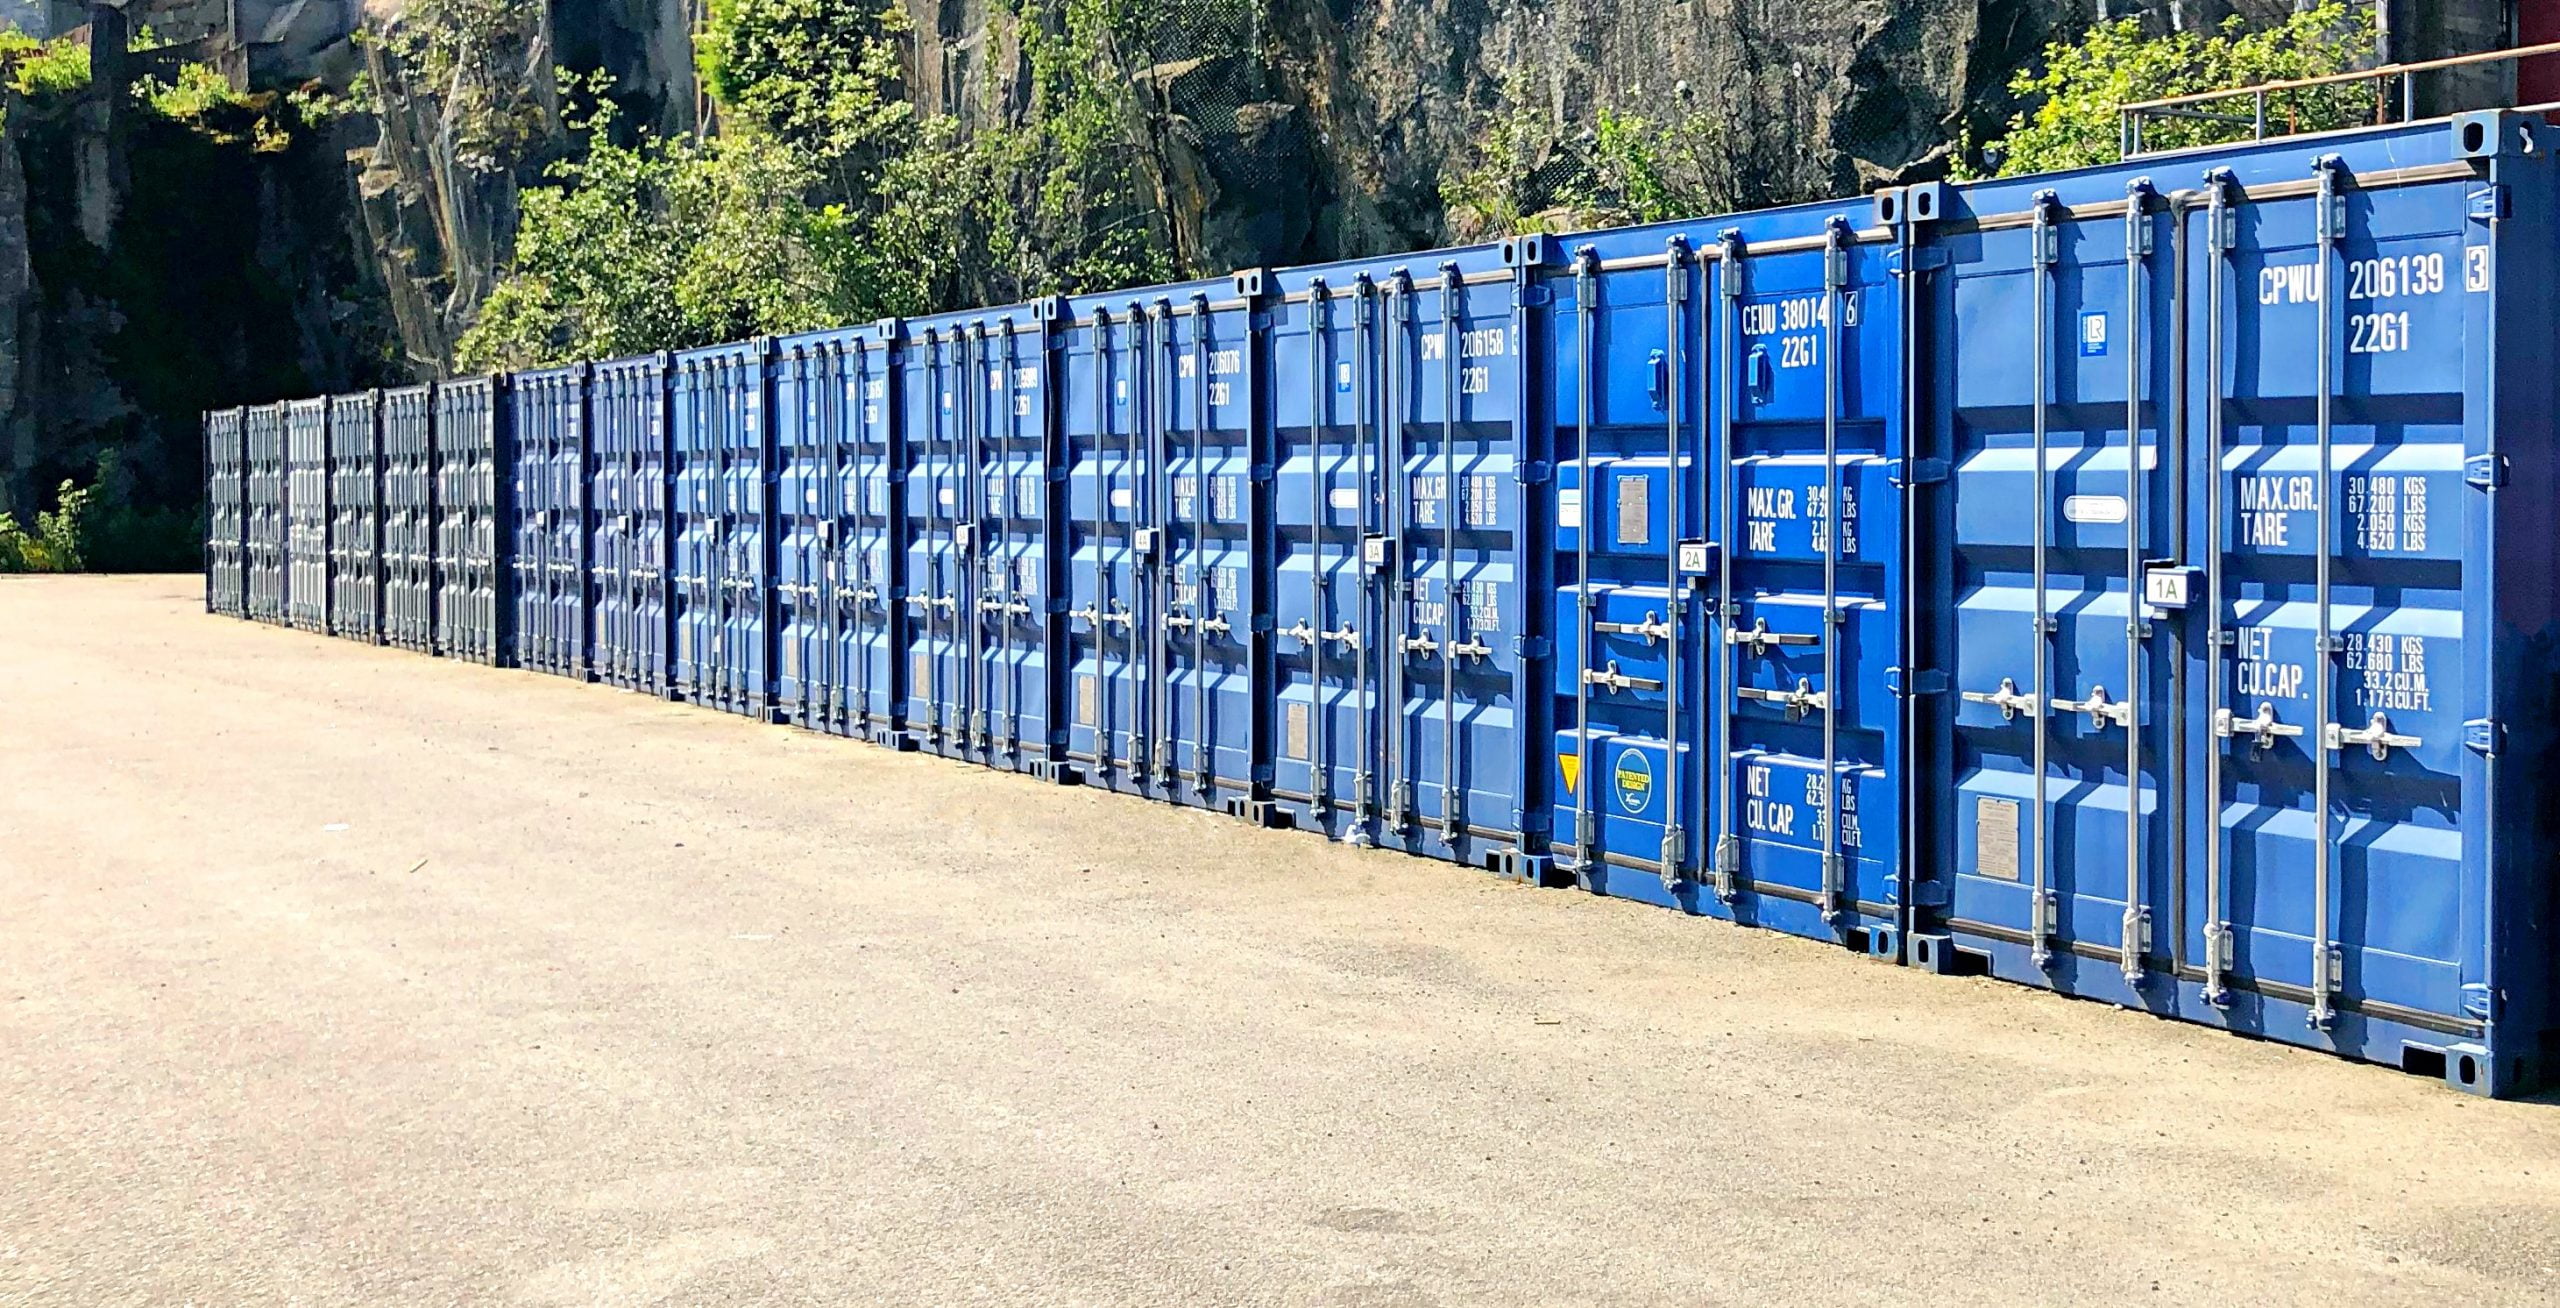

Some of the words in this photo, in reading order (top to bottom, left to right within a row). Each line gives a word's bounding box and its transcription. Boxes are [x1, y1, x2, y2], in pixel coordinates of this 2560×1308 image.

[2259, 263, 2320, 304] CPWU
[2349, 253, 2444, 300] 206139
[2468, 247, 2487, 290] 3
[1742, 303, 1776, 336] CEUU
[1780, 296, 1829, 331] 38014
[1845, 293, 1856, 325] 6
[1421, 334, 1446, 360] CPW
[1461, 328, 1504, 358] 206158
[2350, 311, 2409, 353] 22G1
[1781, 334, 1817, 368] 22G1
[1462, 366, 1488, 394] 22G1
[2240, 476, 2318, 511] MAX.GR.
[2348, 476, 2395, 495] 30.480
[2403, 476, 2426, 495] KGS
[1413, 500, 1436, 524] TARE
[1748, 486, 1797, 520] MAX.GR.
[1842, 502, 1857, 518] LBS
[2348, 496, 2395, 513] 67.200
[2403, 496, 2426, 514] LBS
[2240, 512, 2289, 546] TARE
[2356, 514, 2395, 532] 2.050
[2403, 514, 2426, 532] KGS
[1748, 520, 1776, 552] TARE
[1842, 537, 1857, 553] LBS
[2356, 532, 2395, 550] 4.520
[2403, 532, 2426, 551] LBS
[1369, 544, 1380, 559] 3A
[1685, 551, 1701, 568] 2A
[1414, 577, 1430, 601] NET
[2156, 578, 2178, 600] 1A
[2238, 626, 2272, 661] NET
[2346, 633, 2393, 652] 28.430
[2401, 636, 2424, 654] KGS
[2346, 652, 2393, 671] 62.680
[2401, 654, 2424, 673] LBS
[2238, 661, 2309, 700] CU.CAP.
[1747, 765, 1771, 797] NET
[1842, 794, 1856, 812] LBS
